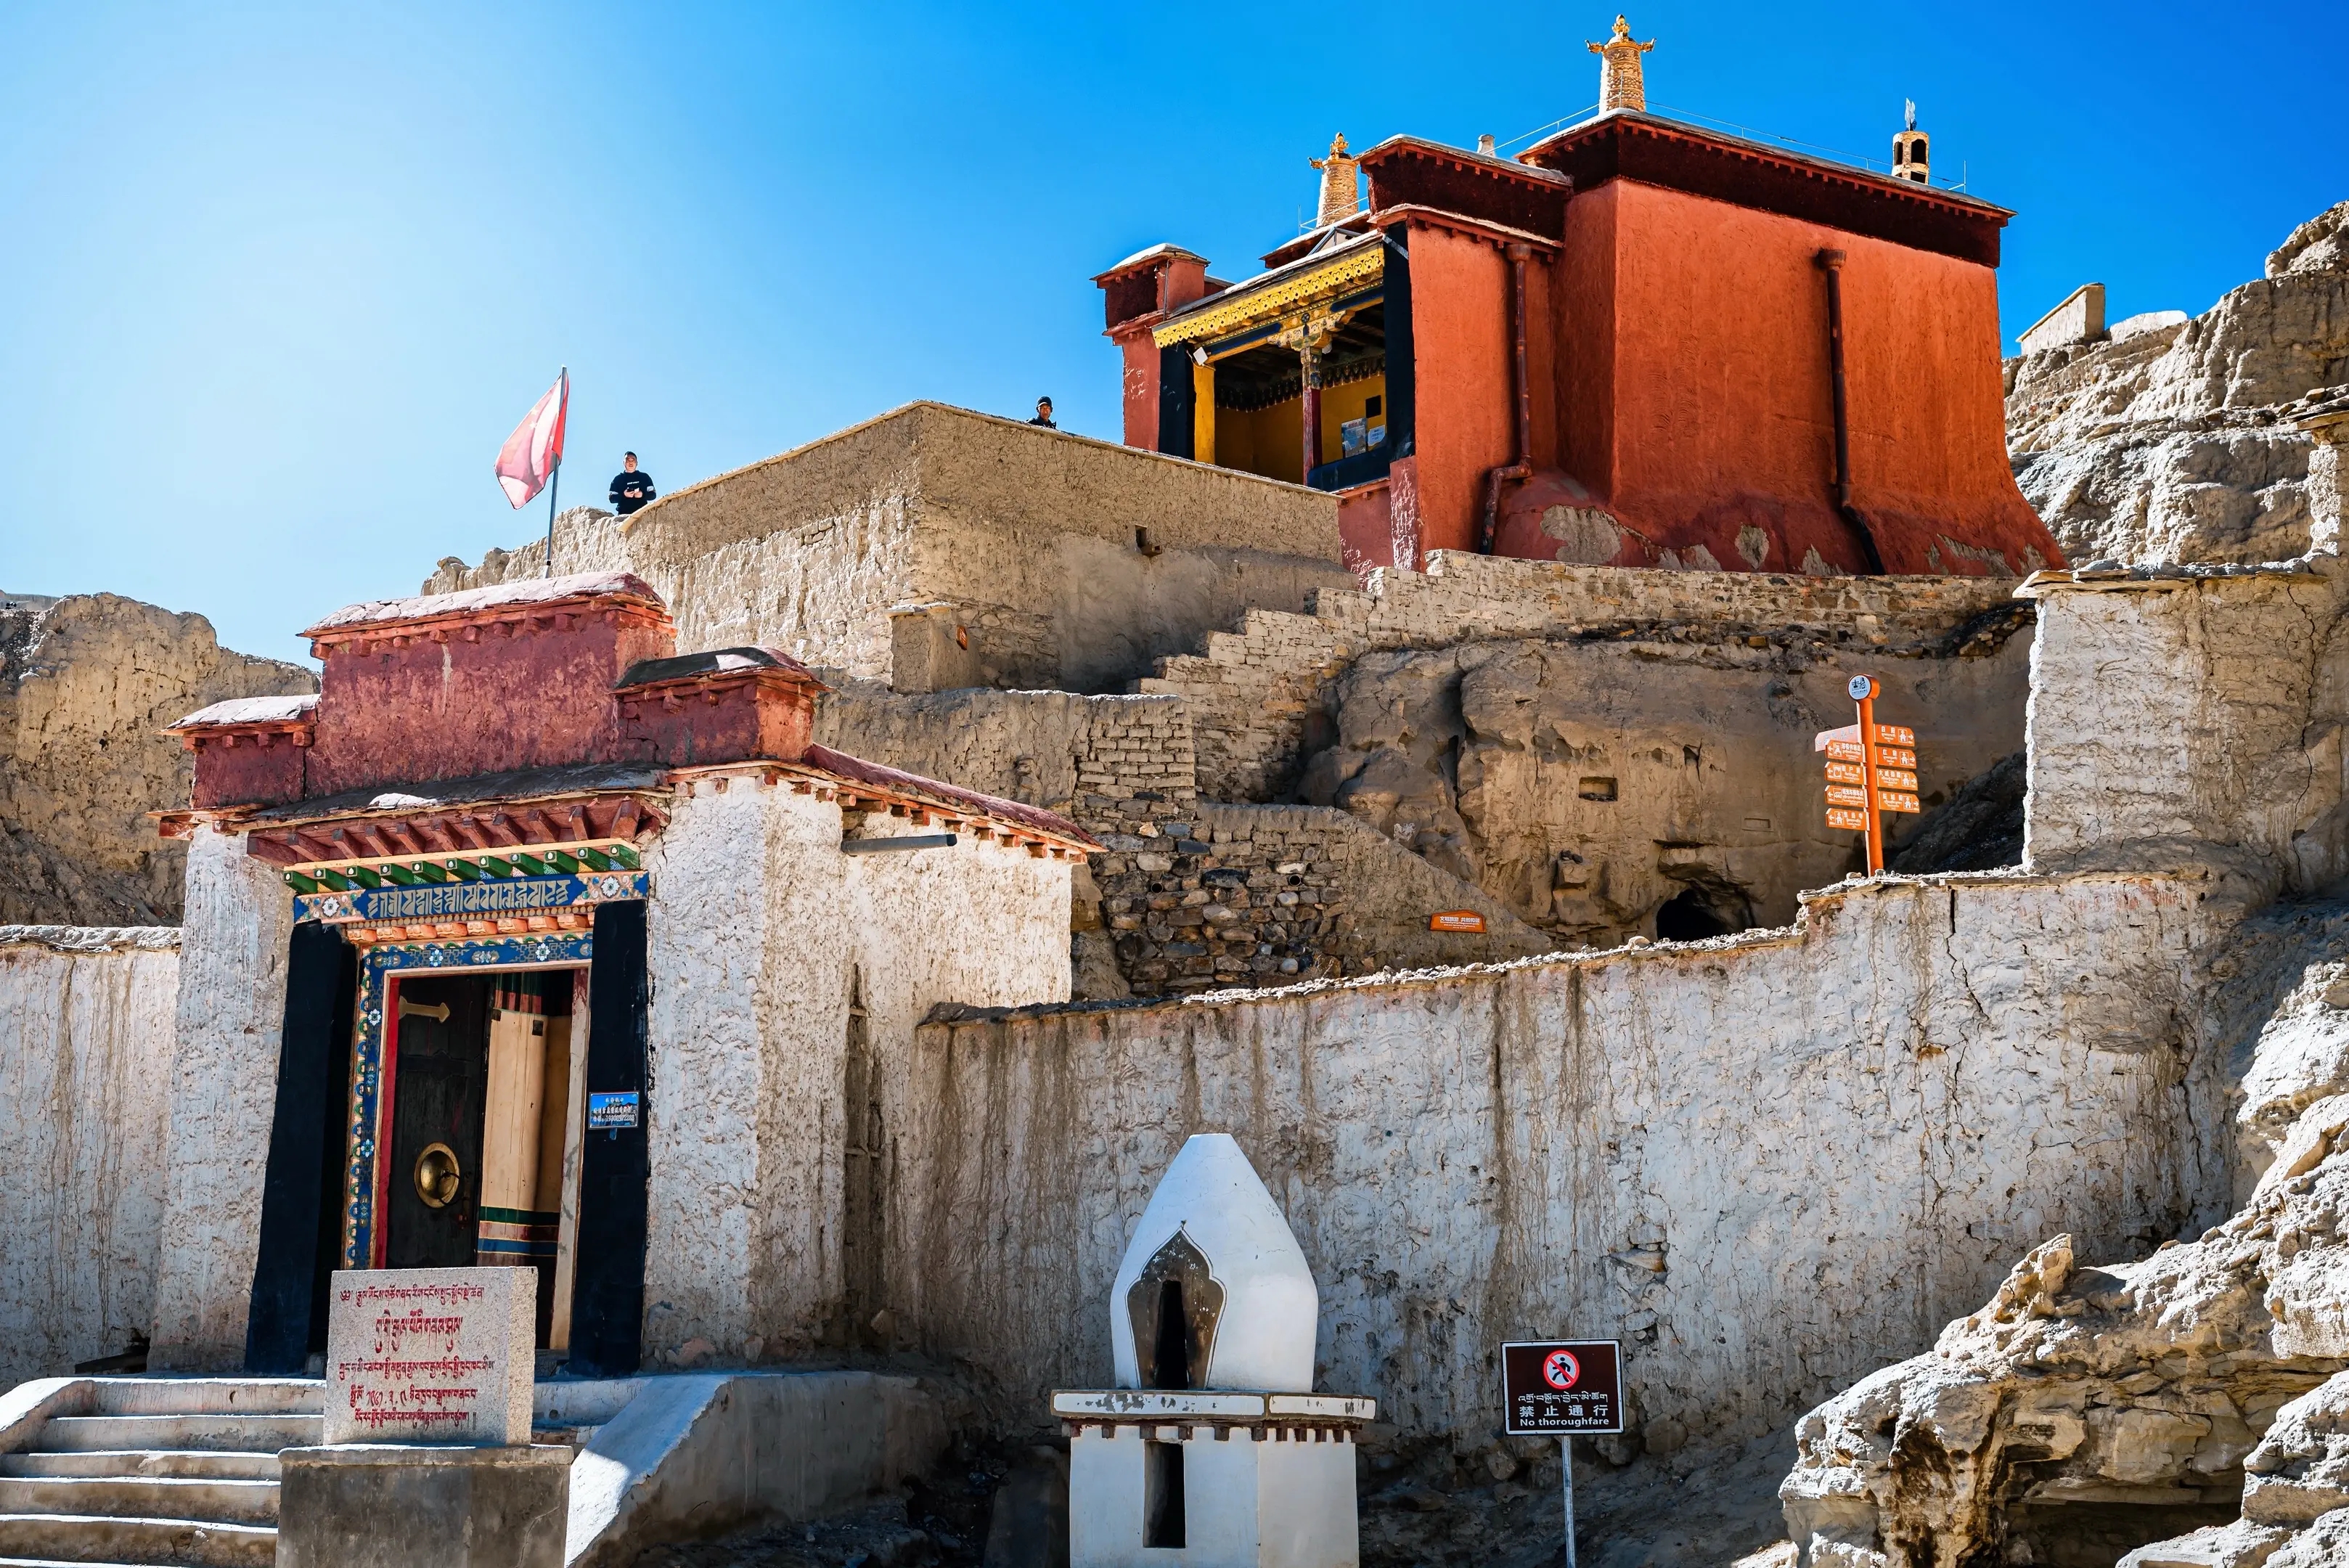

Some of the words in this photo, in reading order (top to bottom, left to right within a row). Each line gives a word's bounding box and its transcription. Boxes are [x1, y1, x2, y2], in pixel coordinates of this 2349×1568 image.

[1519, 1405, 1609, 1418] 禁止通行
[1538, 1417, 1609, 1427] thoroughfare
